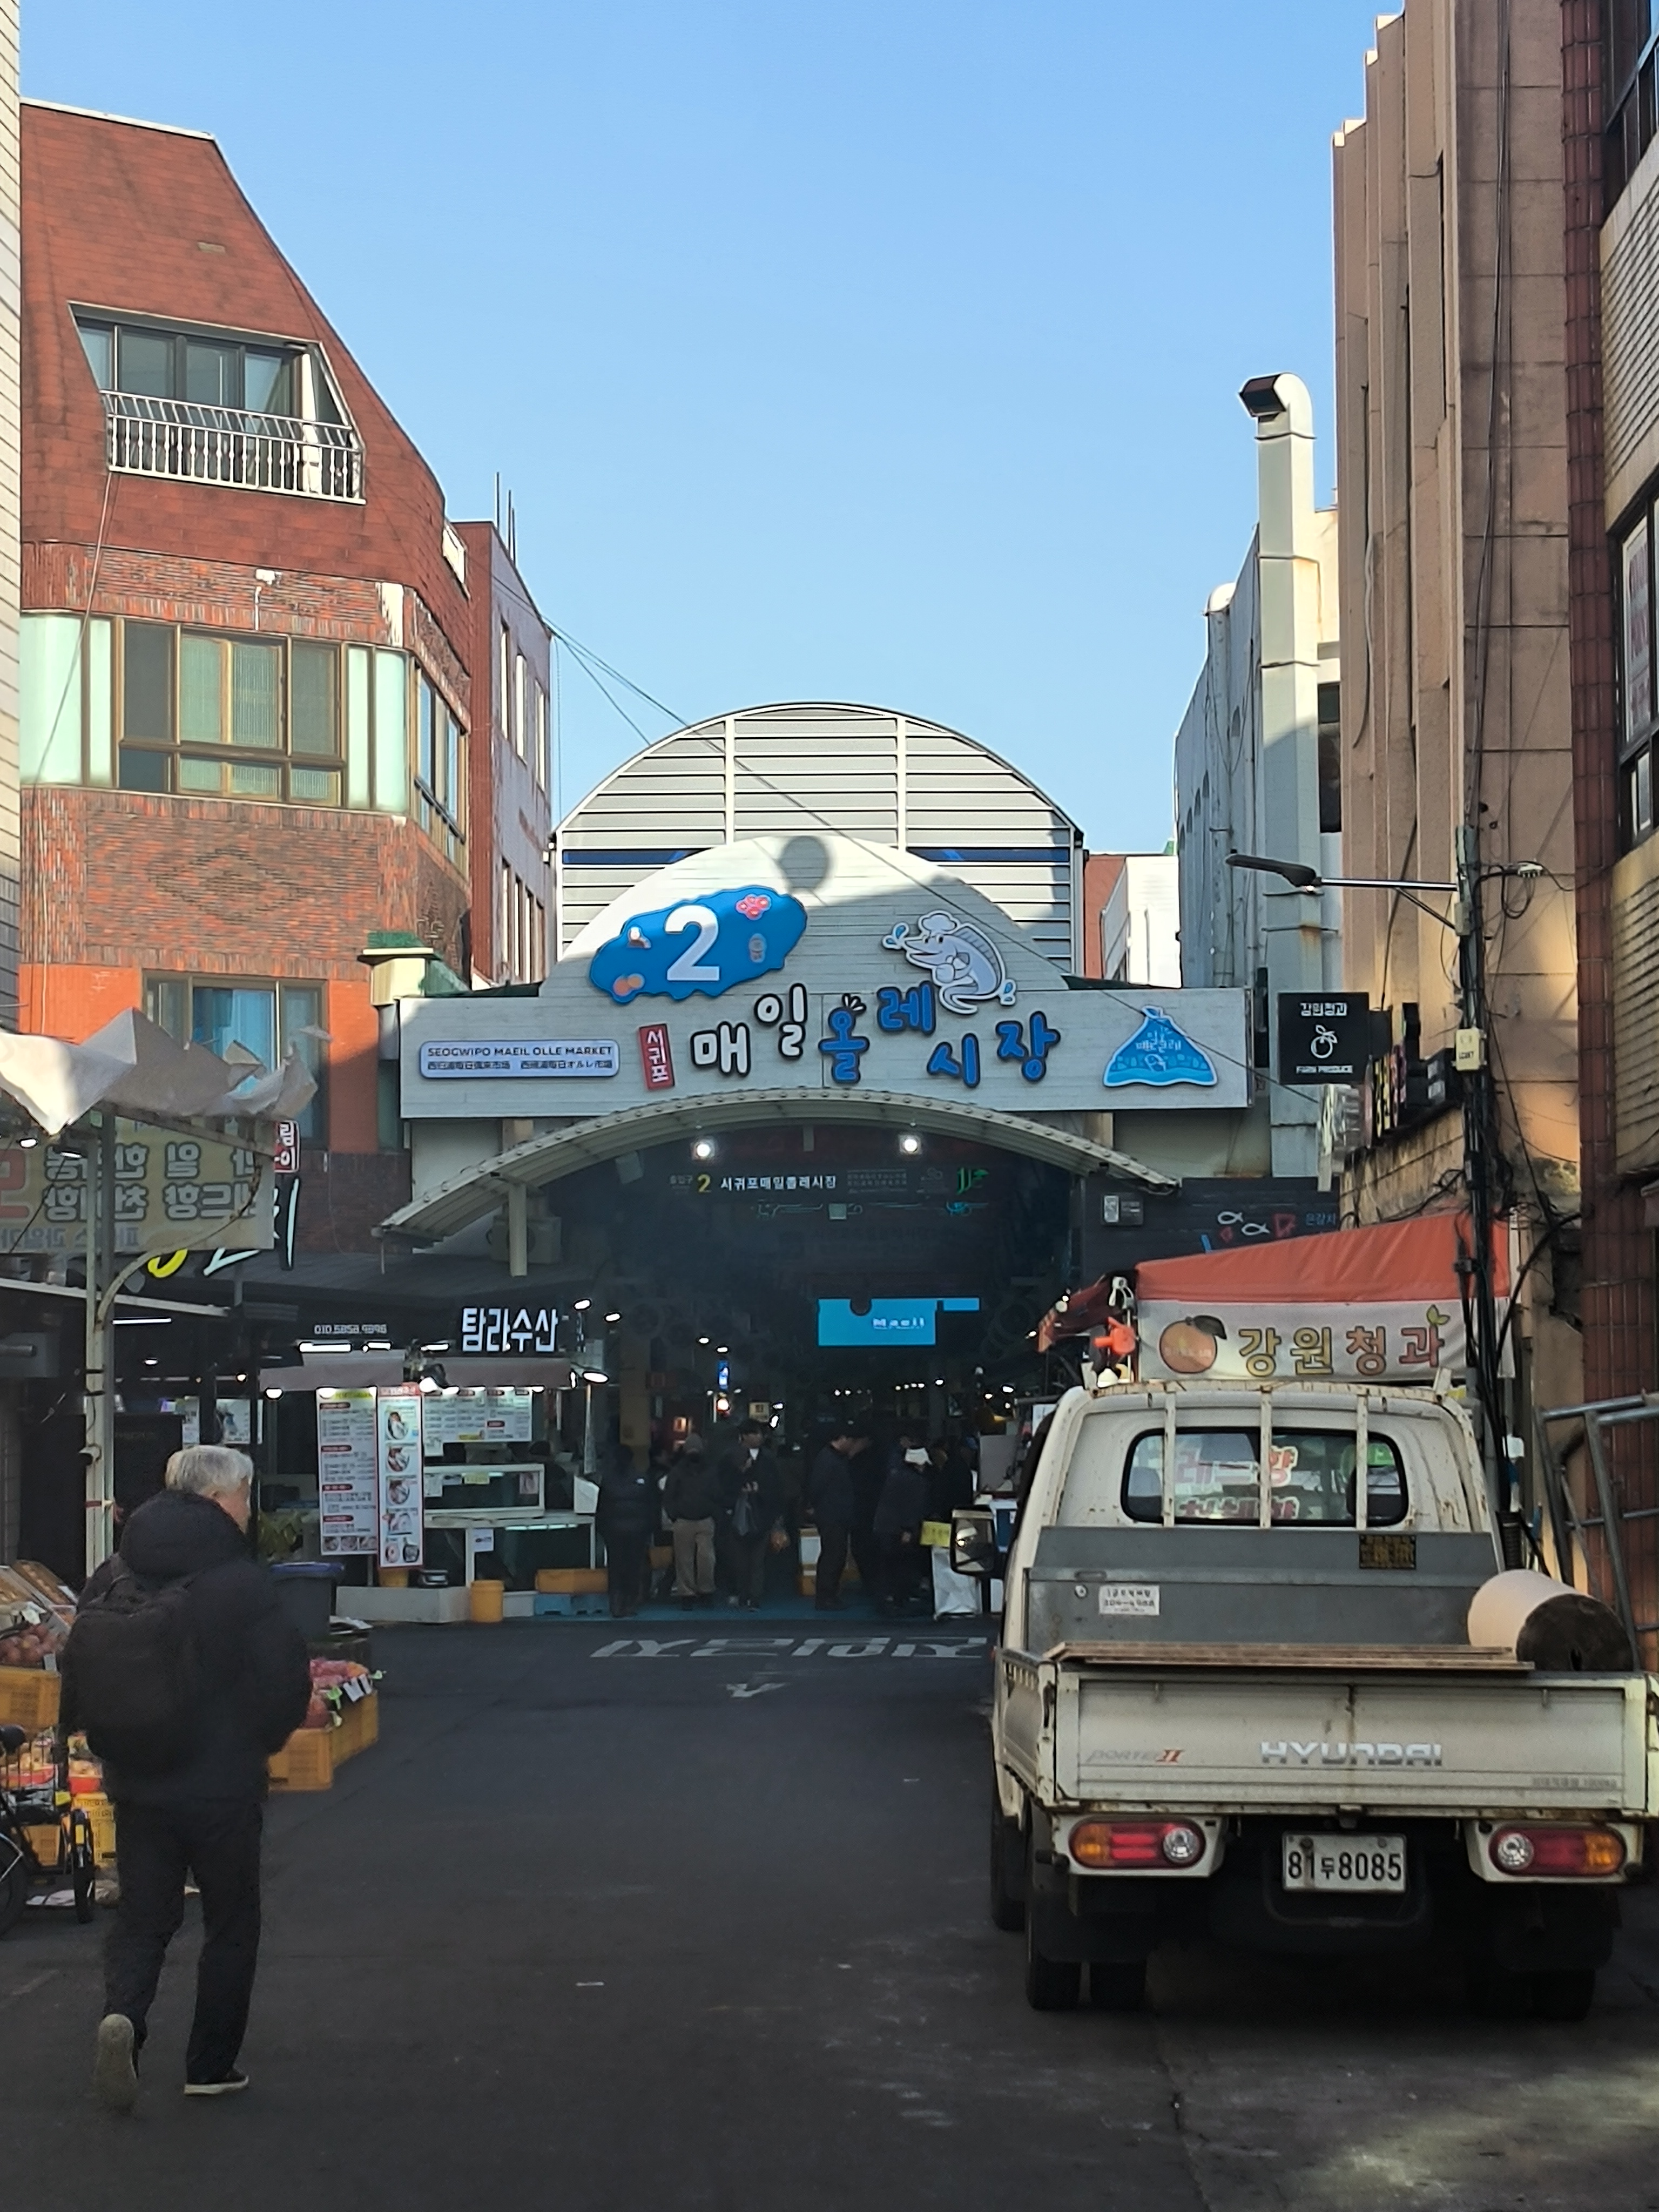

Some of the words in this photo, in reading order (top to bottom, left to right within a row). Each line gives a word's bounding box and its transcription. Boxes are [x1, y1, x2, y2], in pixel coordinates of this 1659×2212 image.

[665, 905, 720, 982] 2
[1300, 1002, 1347, 1016] 강원청과
[428, 1047, 491, 1057] SEOGWIPO
[494, 1047, 530, 1056] MAEIL
[532, 1047, 562, 1056] OLLE
[565, 1046, 612, 1055] MARKET
[645, 1029, 671, 1084] 서귀포
[697, 1174, 711, 1193] 2
[461, 1307, 558, 1352] 탐라수산
[1238, 1325, 1445, 1377] 강원청과
[1260, 1741, 1442, 1766] HYUNDAI
